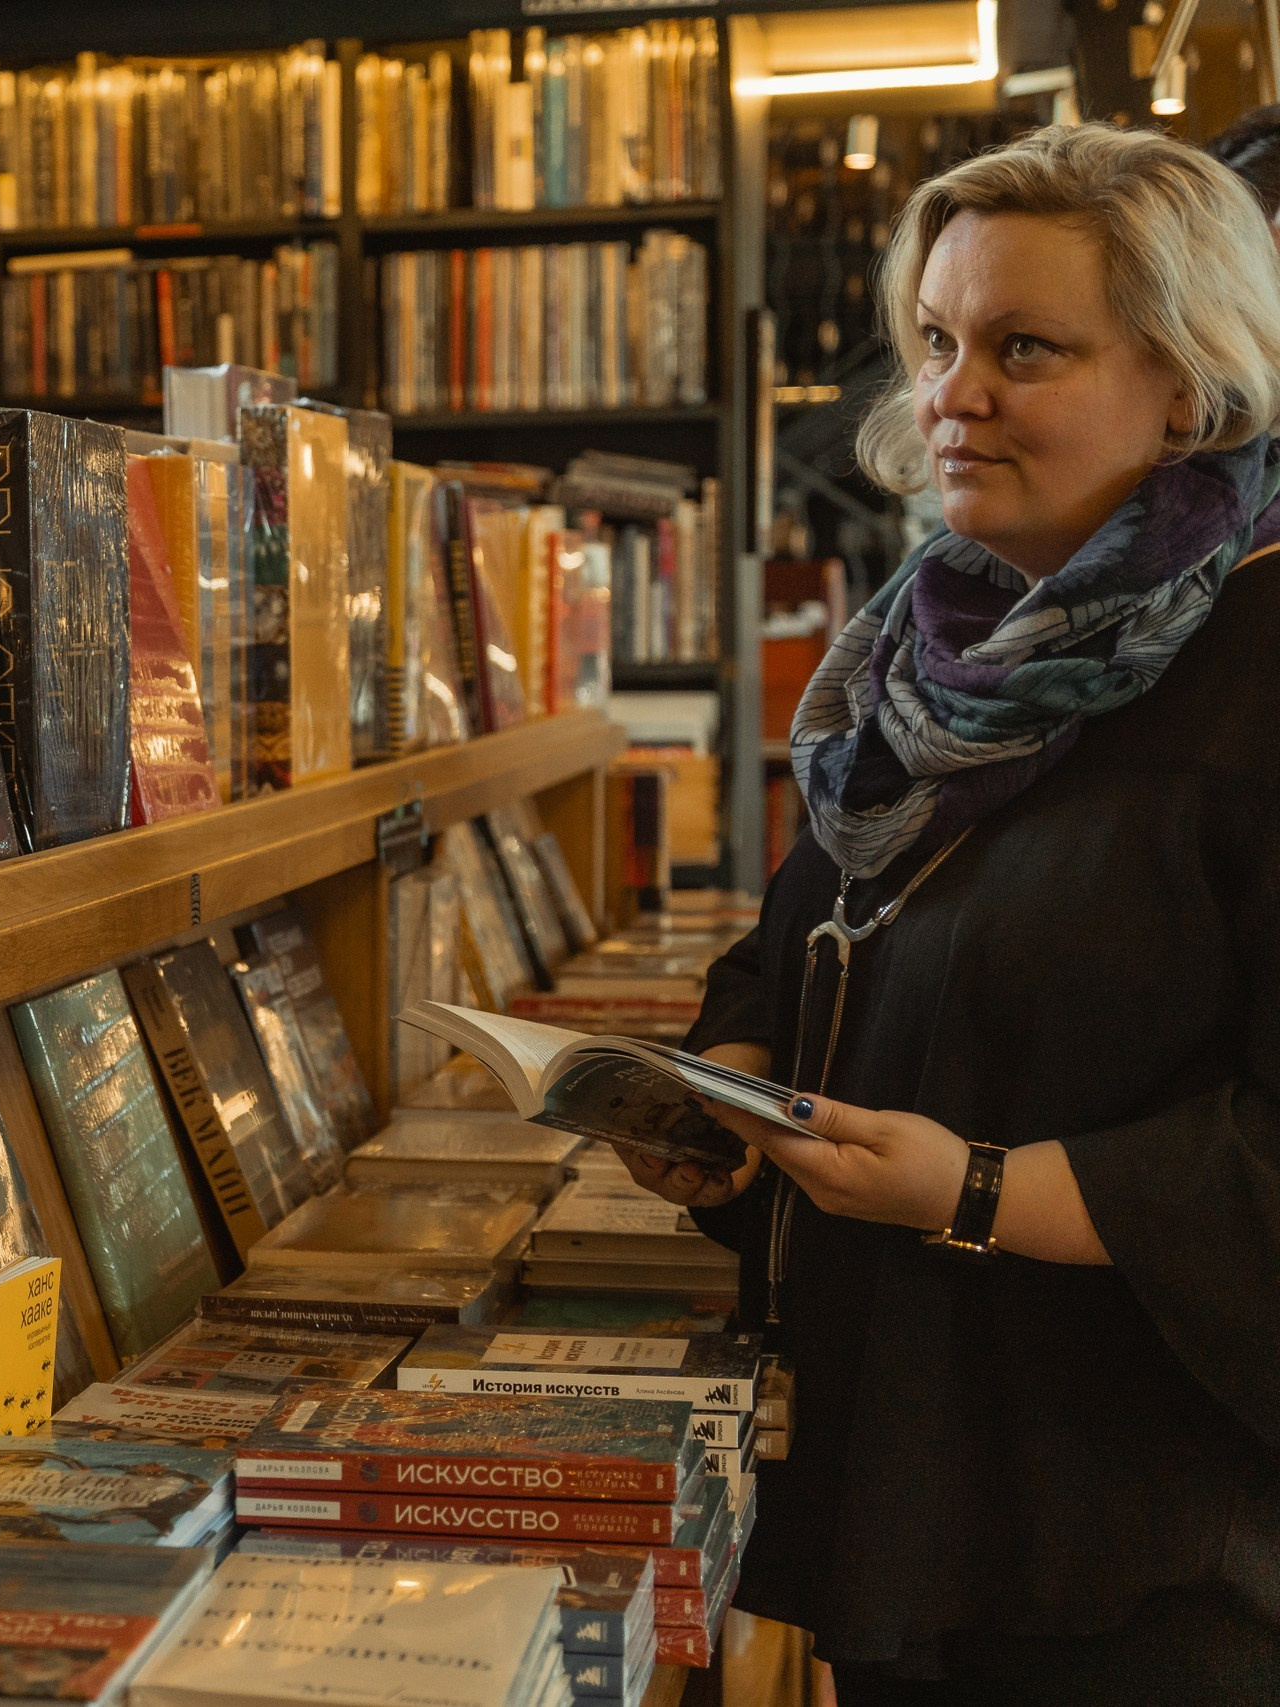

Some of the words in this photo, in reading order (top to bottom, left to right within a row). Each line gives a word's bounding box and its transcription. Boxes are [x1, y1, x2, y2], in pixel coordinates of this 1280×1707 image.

[27, 1270, 54, 1300] ханс
[20, 1298, 53, 1329] хааке
[250, 1310, 278, 1319] ВРЕМЯ
[472, 1378, 543, 1396] История
[545, 1383, 620, 1398] искусств
[635, 1387, 655, 1395] Алина
[656, 1387, 685, 1396] Аксёнова
[170, 1419, 257, 1429] ХУДОЖНИ
[256, 1464, 285, 1473] ДАРЬЯ
[289, 1465, 329, 1474] КОЗЛОВА
[397, 1463, 563, 1489] ИСКУССТВО
[577, 1470, 642, 1480] ИСКУССТВО
[579, 1480, 640, 1490] ПОНИМАТЬ
[255, 1503, 284, 1512] ДАРЬЯ
[287, 1504, 328, 1513] КОЗЛОВА
[395, 1504, 559, 1531] ИСКУССТВО
[573, 1514, 638, 1523] ИСКУССТВО
[576, 1523, 636, 1533] ПОНИМАТЬ
